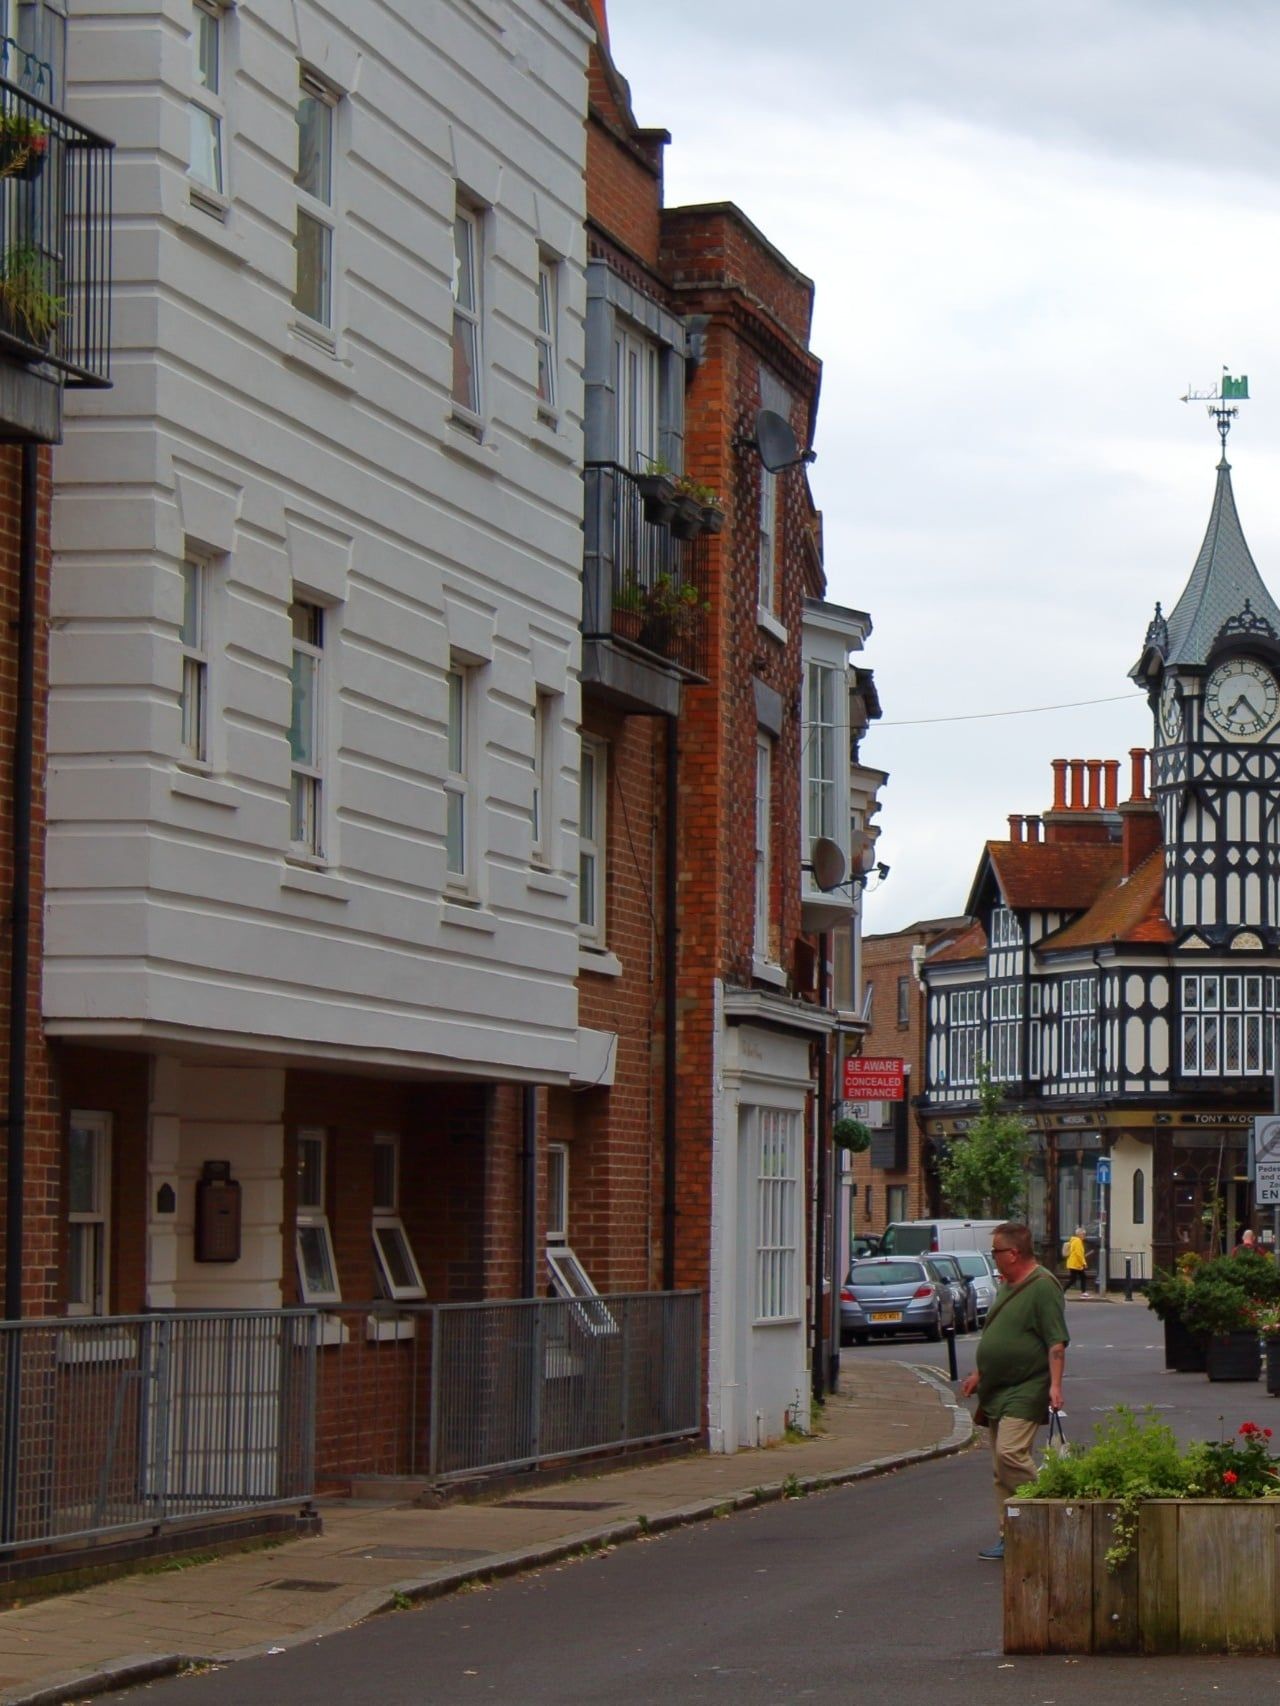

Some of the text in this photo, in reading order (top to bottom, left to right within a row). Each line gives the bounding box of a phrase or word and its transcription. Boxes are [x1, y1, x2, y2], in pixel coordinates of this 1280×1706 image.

[847, 1060, 899, 1071] BE AWARE
[845, 1077, 901, 1087] CONCEALED
[848, 1088, 897, 1097] ENTRANCE
[1194, 1114, 1222, 1123] TONY
